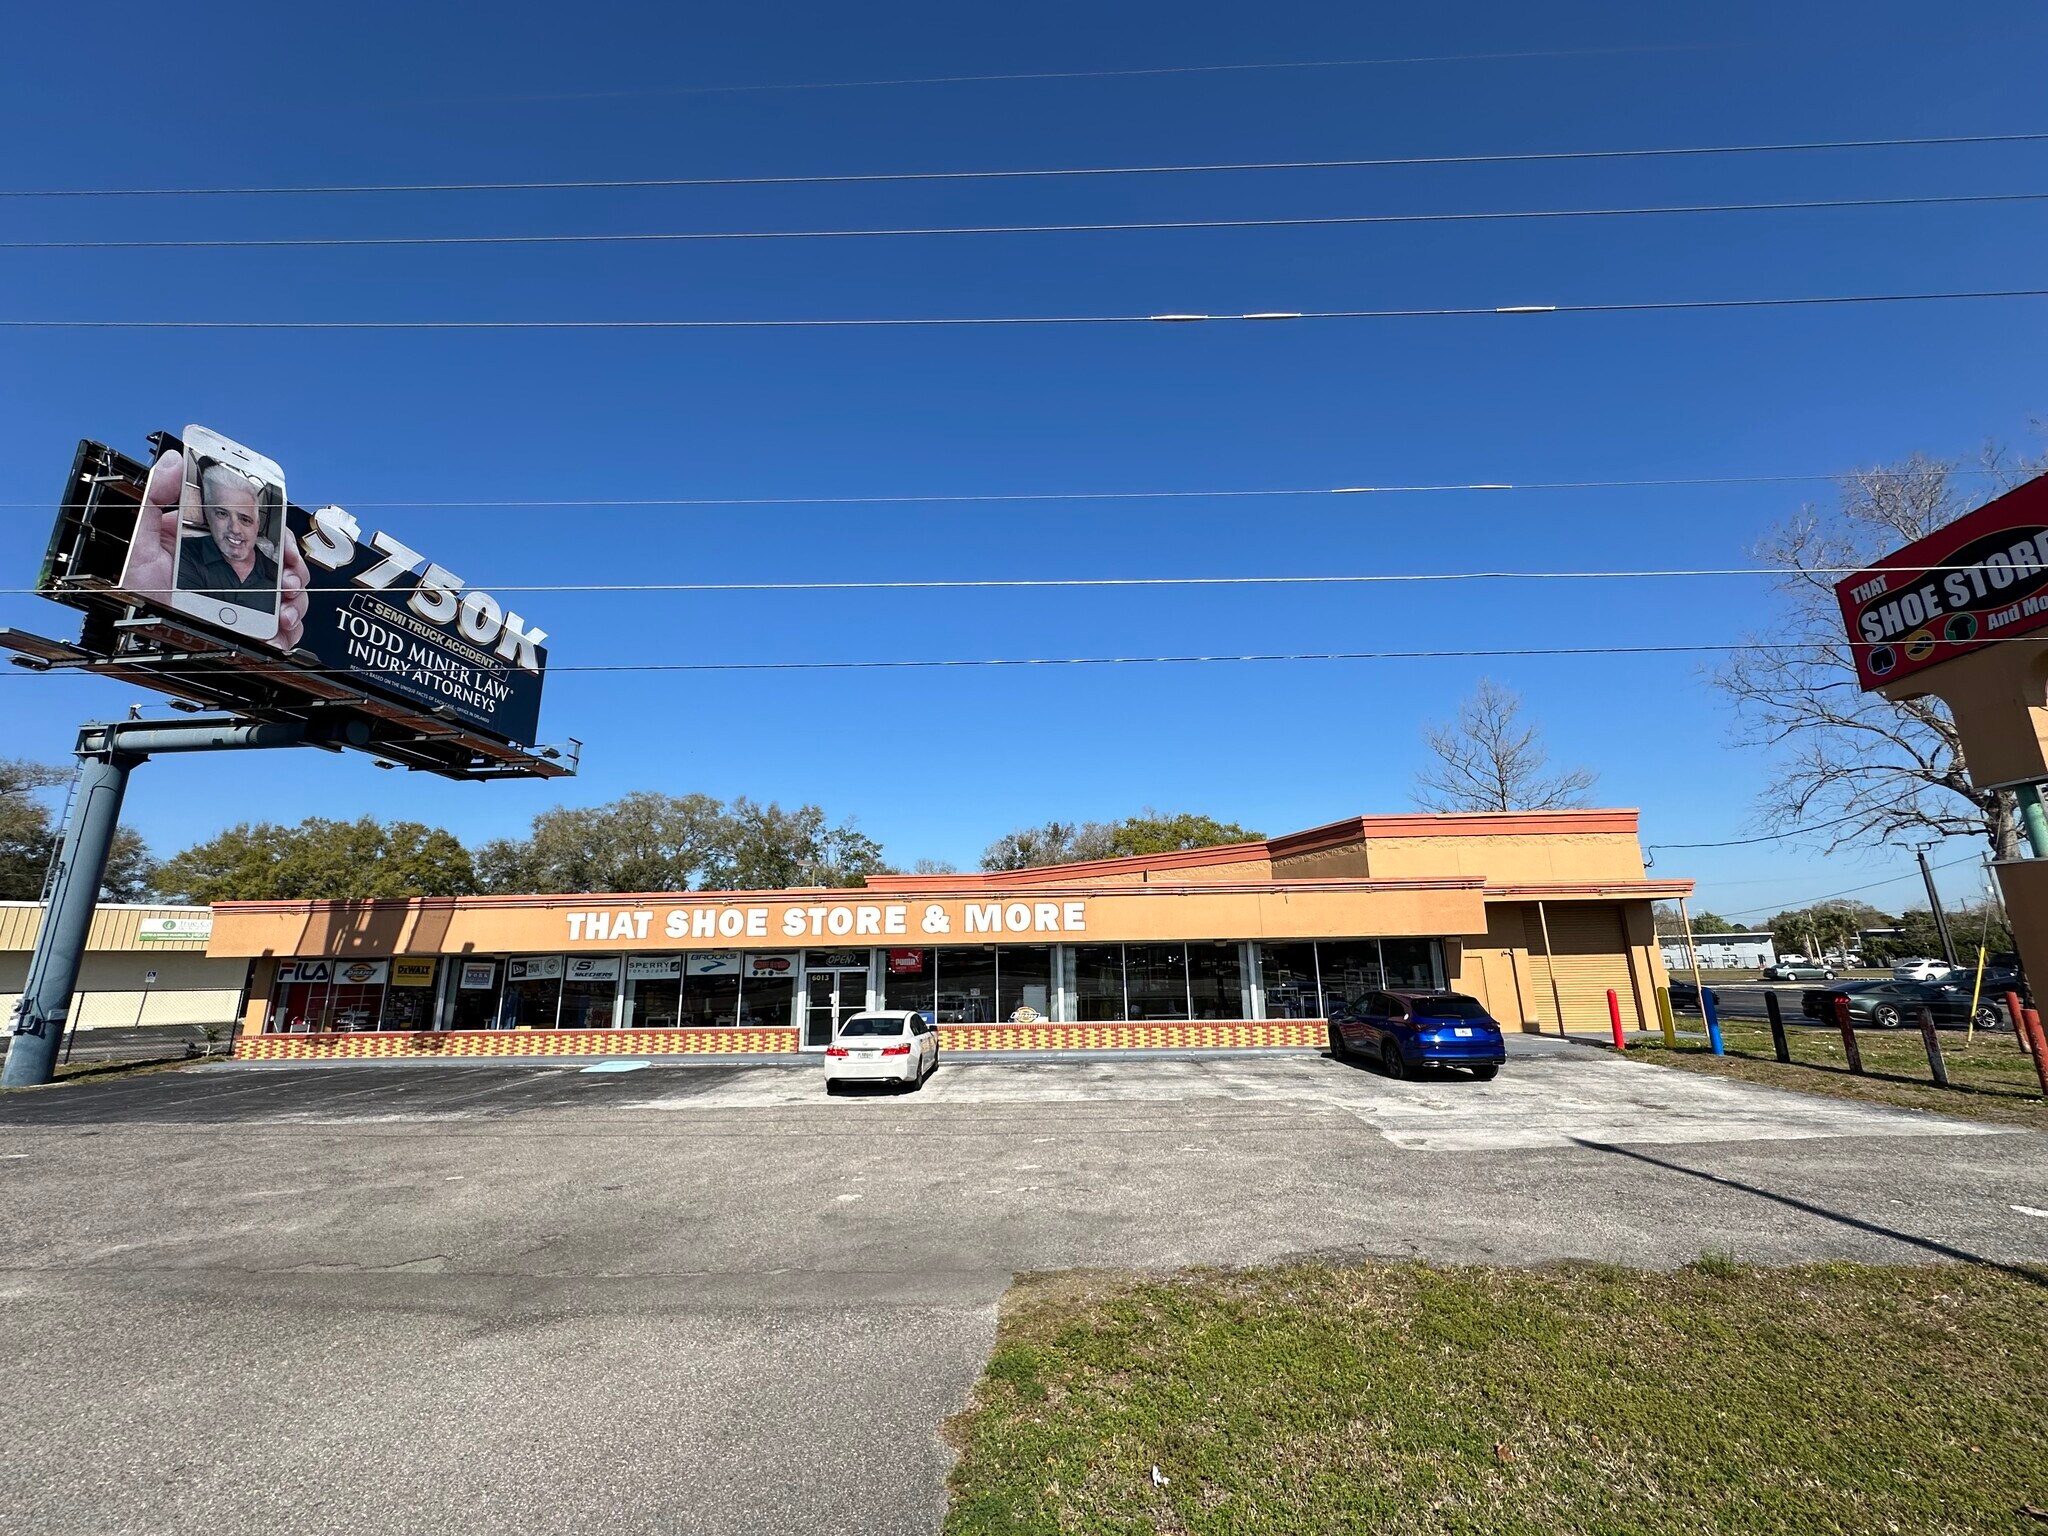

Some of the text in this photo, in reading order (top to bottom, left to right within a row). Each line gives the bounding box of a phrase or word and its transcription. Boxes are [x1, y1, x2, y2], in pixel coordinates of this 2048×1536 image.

[299, 504, 548, 676] $750K
[1850, 574, 1887, 605] THAT
[1861, 584, 1943, 642] SHOE
[1987, 604, 2021, 631] And
[335, 607, 403, 654] TODD
[407, 642, 471, 686] MINER
[374, 603, 496, 669] SEMI TRUCK ACCIDENT
[347, 639, 496, 713] INJURY ATTORNEYS
[566, 902, 1087, 941] THAT SHOE STORE & MORE
[278, 962, 329, 981] FILA
[690, 953, 737, 961] BROOKS
[828, 954, 852, 964] OPEN
[895, 958, 916, 966] PUMA
